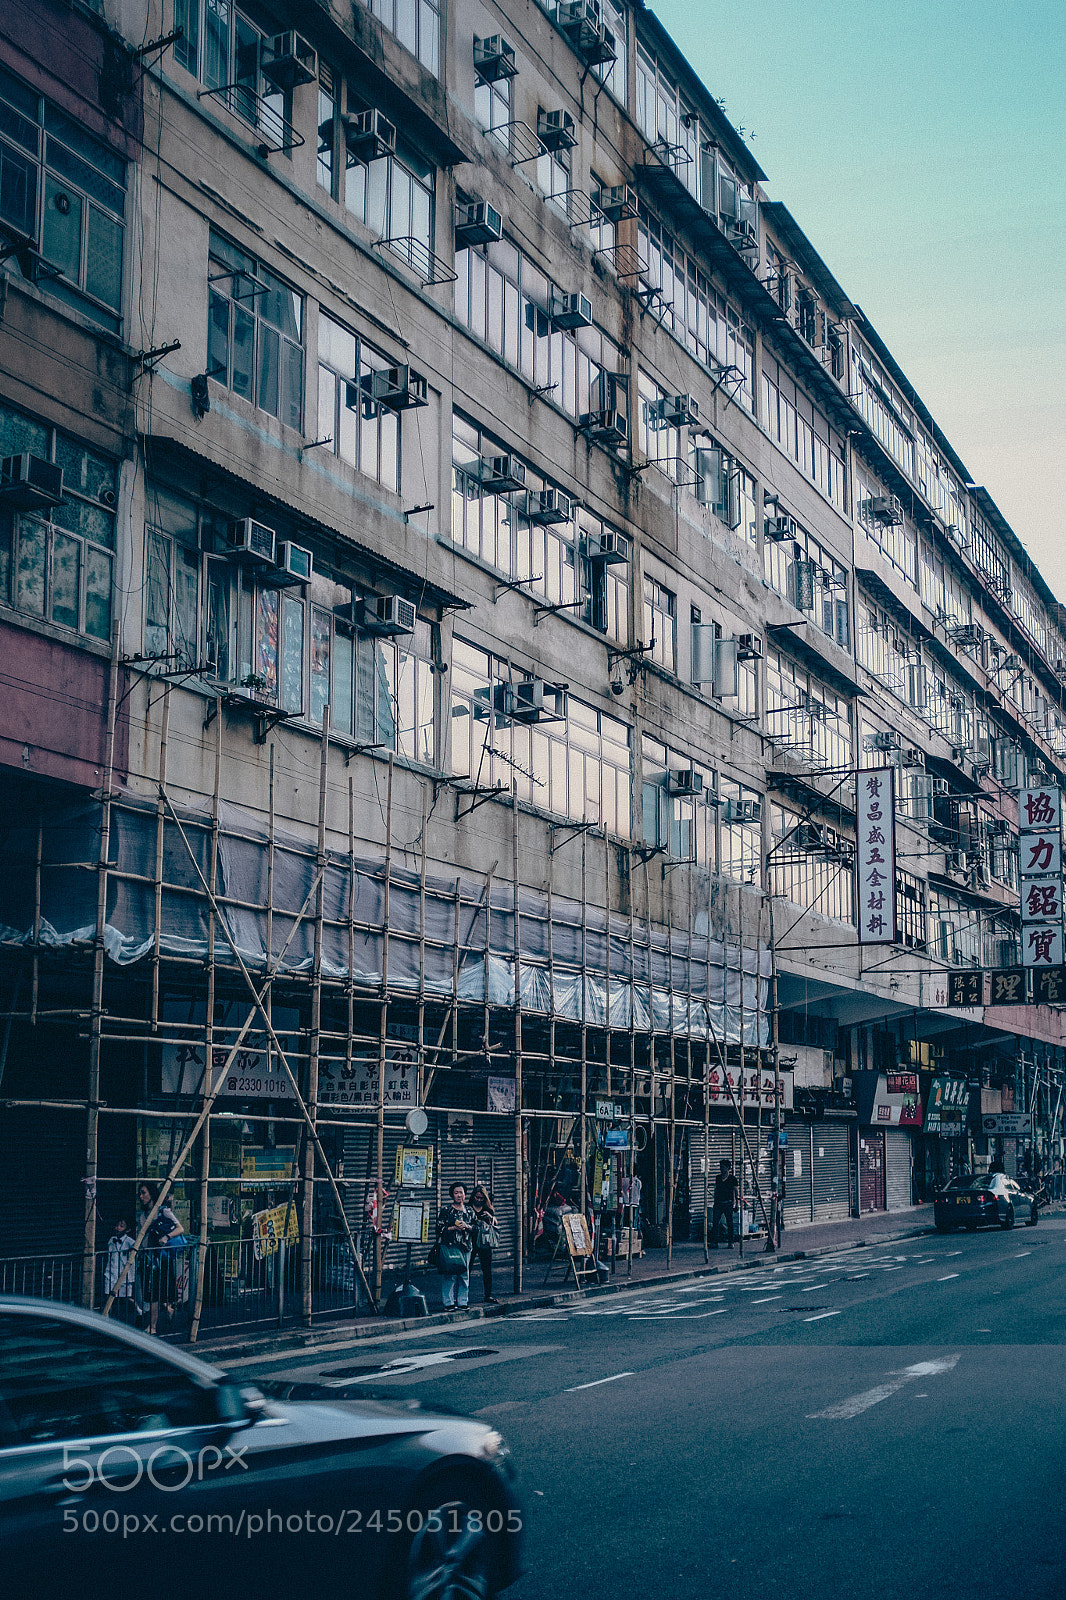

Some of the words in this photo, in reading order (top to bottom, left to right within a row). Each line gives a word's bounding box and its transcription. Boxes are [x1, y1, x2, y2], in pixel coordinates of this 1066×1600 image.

[1023, 791, 1059, 964] 協力鋁質
[239, 1078, 261, 1091] 2330
[265, 1080, 286, 1092] 1016
[599, 1106, 609, 1115] 6A
